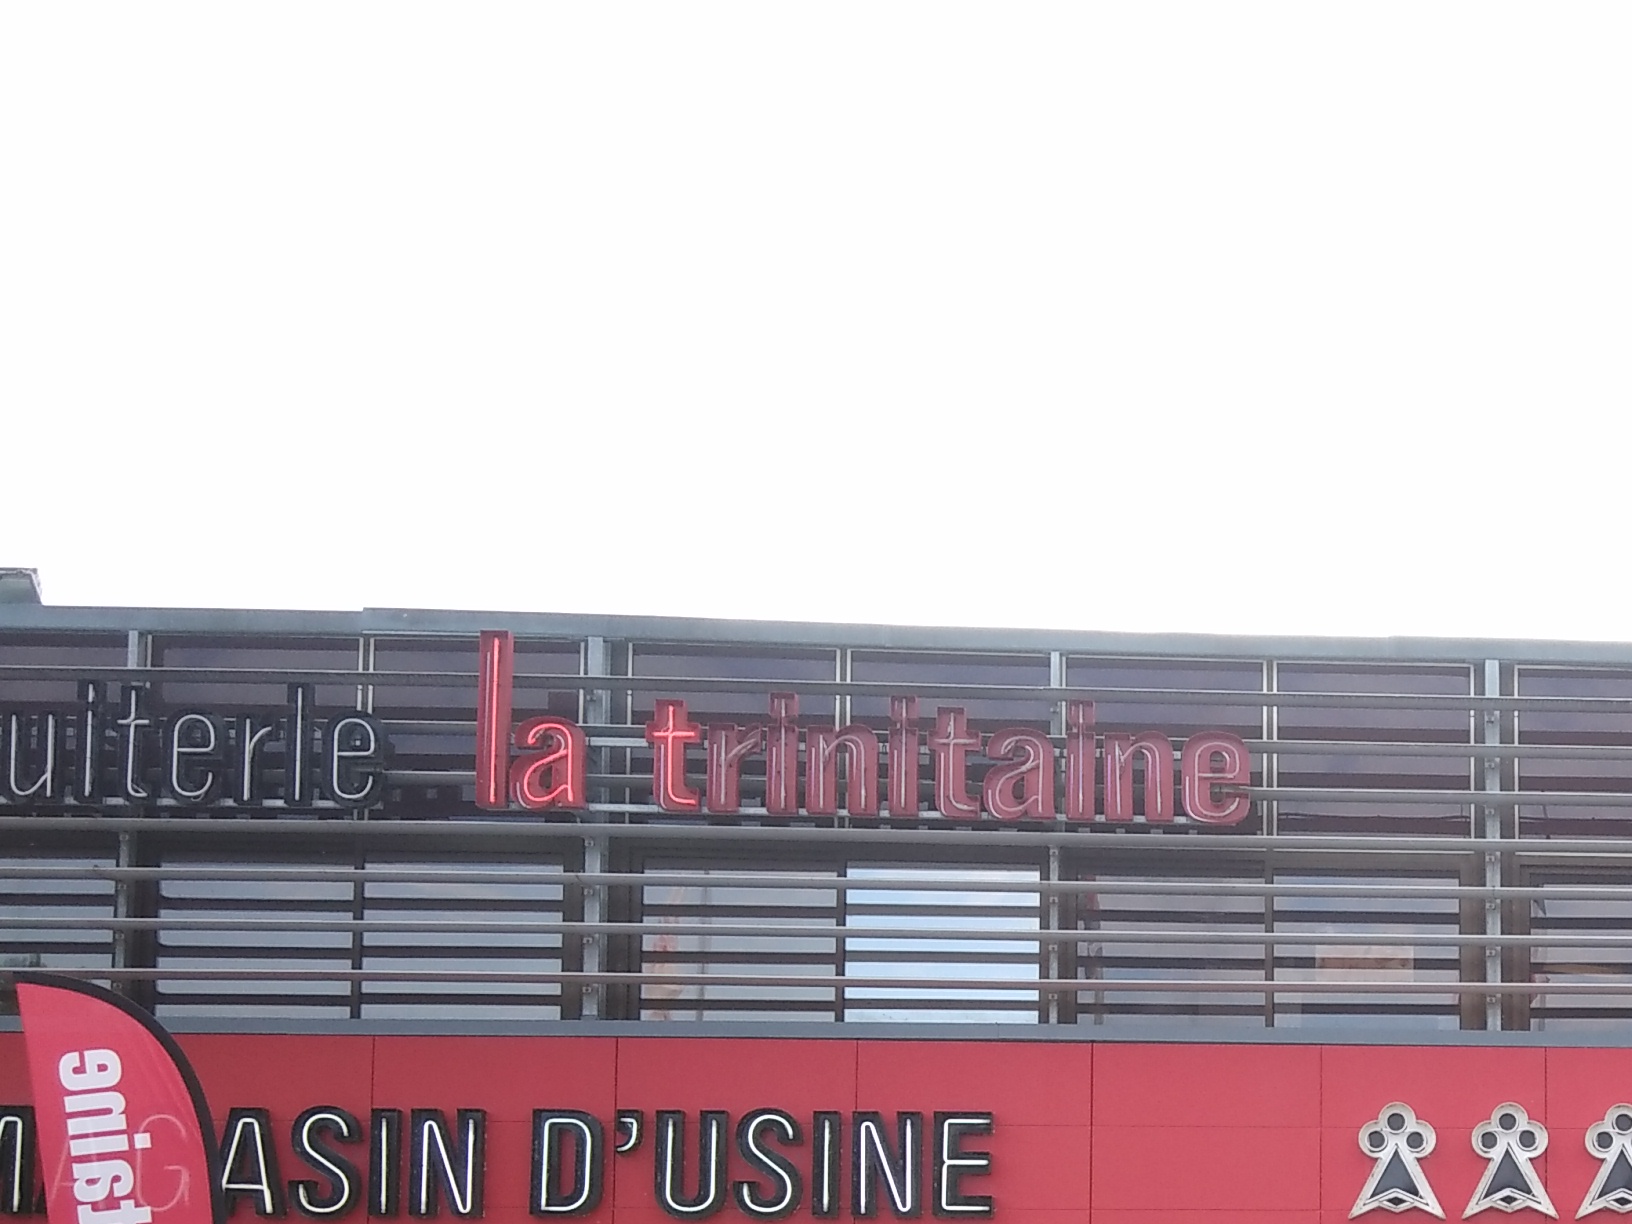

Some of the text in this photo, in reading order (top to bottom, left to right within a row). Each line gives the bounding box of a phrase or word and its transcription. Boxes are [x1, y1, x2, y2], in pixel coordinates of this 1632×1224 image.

[476, 629, 587, 811] la
[645, 691, 1251, 826] trinitaine
[529, 1107, 995, 1220] D'USINE
